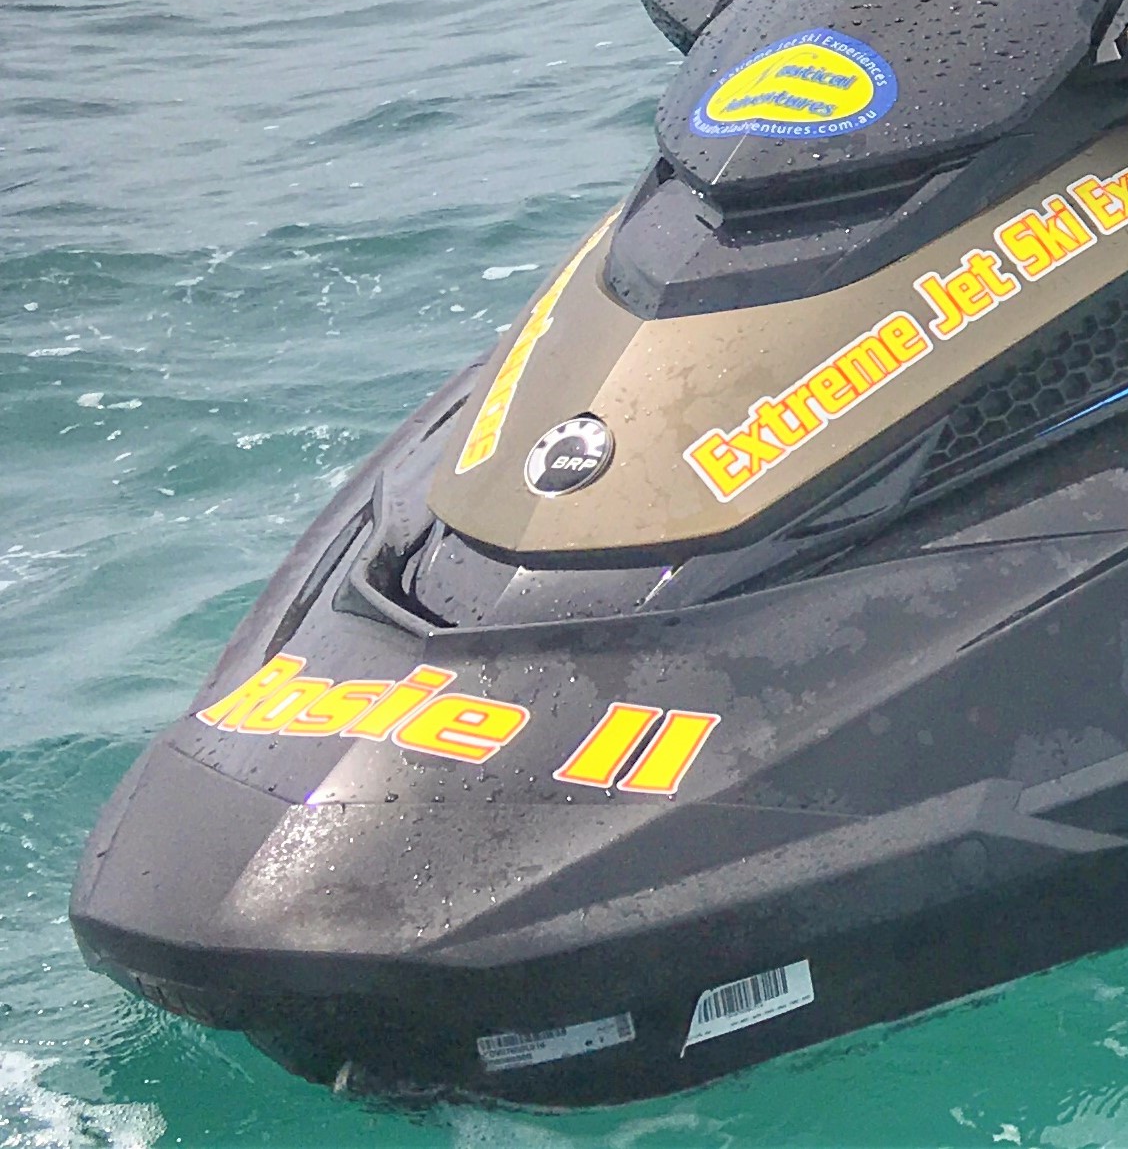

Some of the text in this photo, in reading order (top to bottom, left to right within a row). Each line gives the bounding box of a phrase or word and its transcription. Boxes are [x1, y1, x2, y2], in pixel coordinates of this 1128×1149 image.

[822, 35, 888, 87] Experiences
[685, 311, 932, 502] Extreme
[914, 250, 1020, 339] Jet
[995, 195, 1097, 282] Ski
[551, 455, 598, 472] BRP
[197, 653, 721, 794] Rosie II
